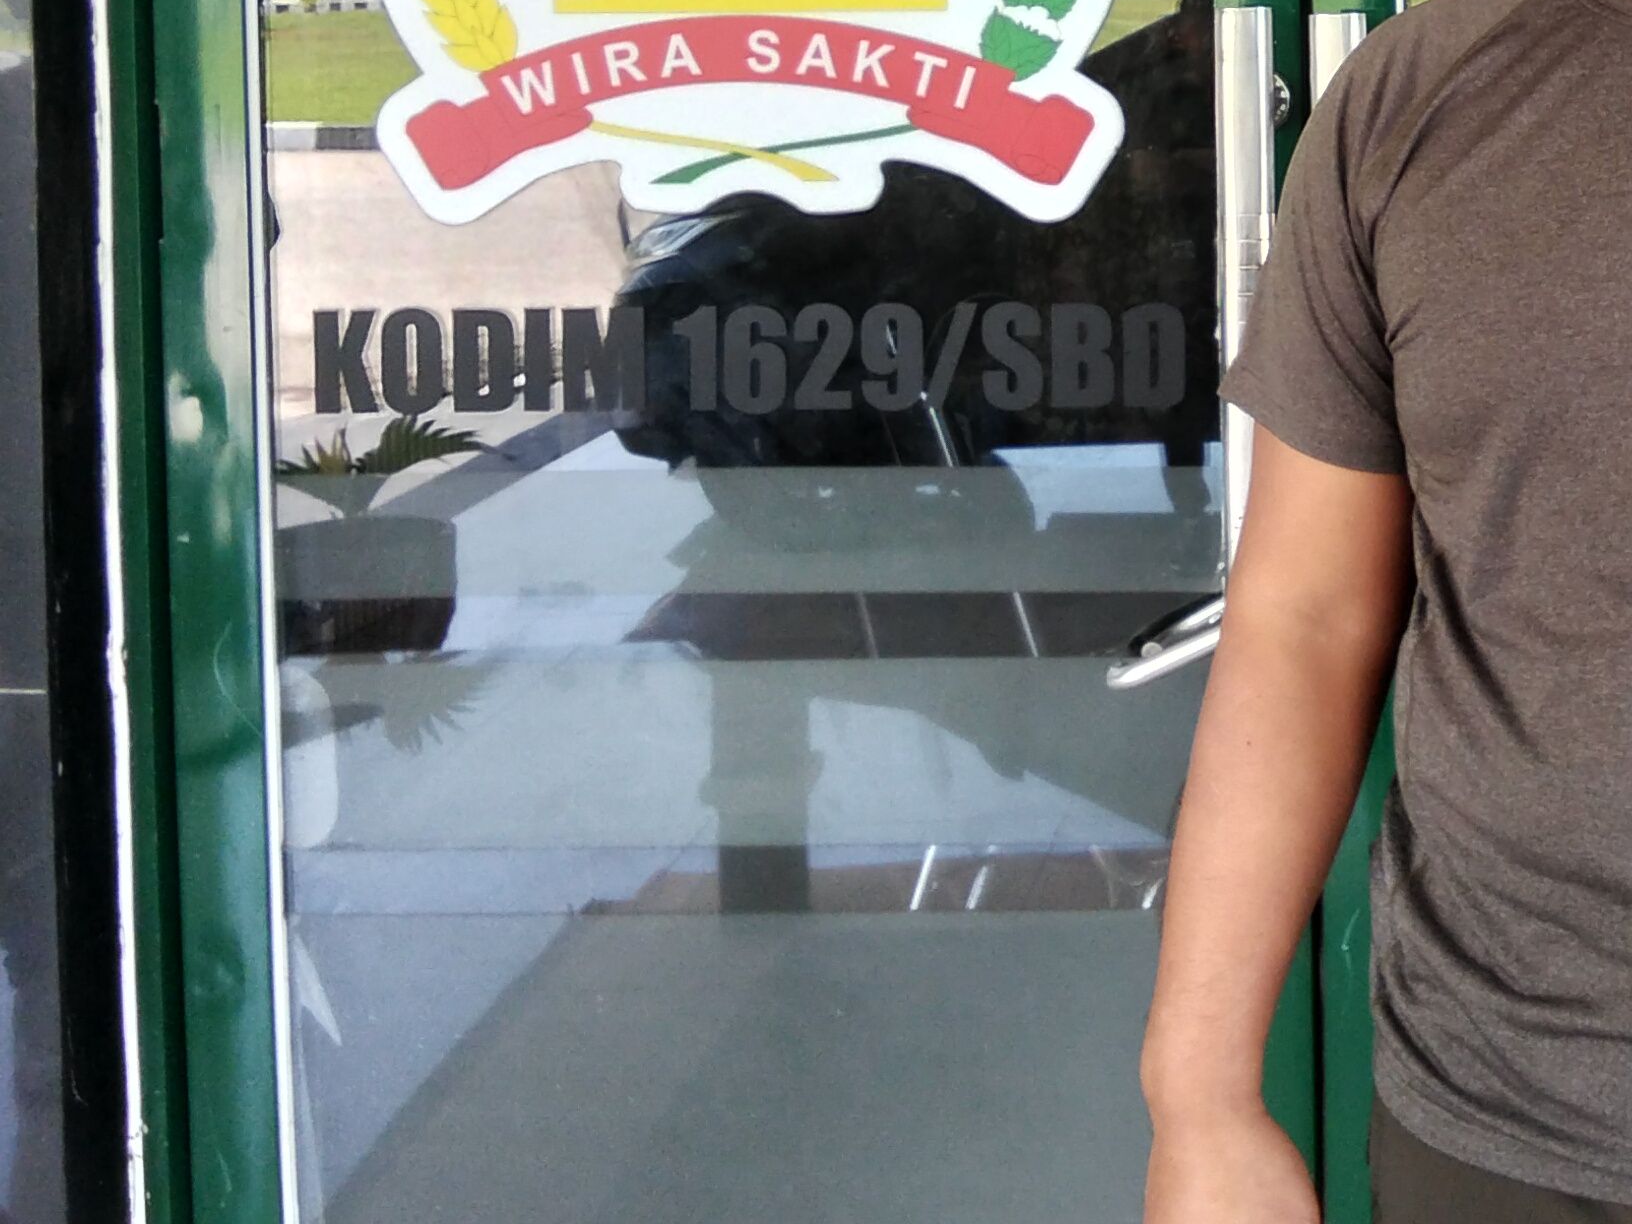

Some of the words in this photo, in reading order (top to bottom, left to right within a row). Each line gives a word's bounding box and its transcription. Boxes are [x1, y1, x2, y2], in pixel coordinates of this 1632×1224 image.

[498, 32, 703, 116] WIRA
[747, 28, 977, 110] SAKTI
[313, 306, 645, 417] KODIM
